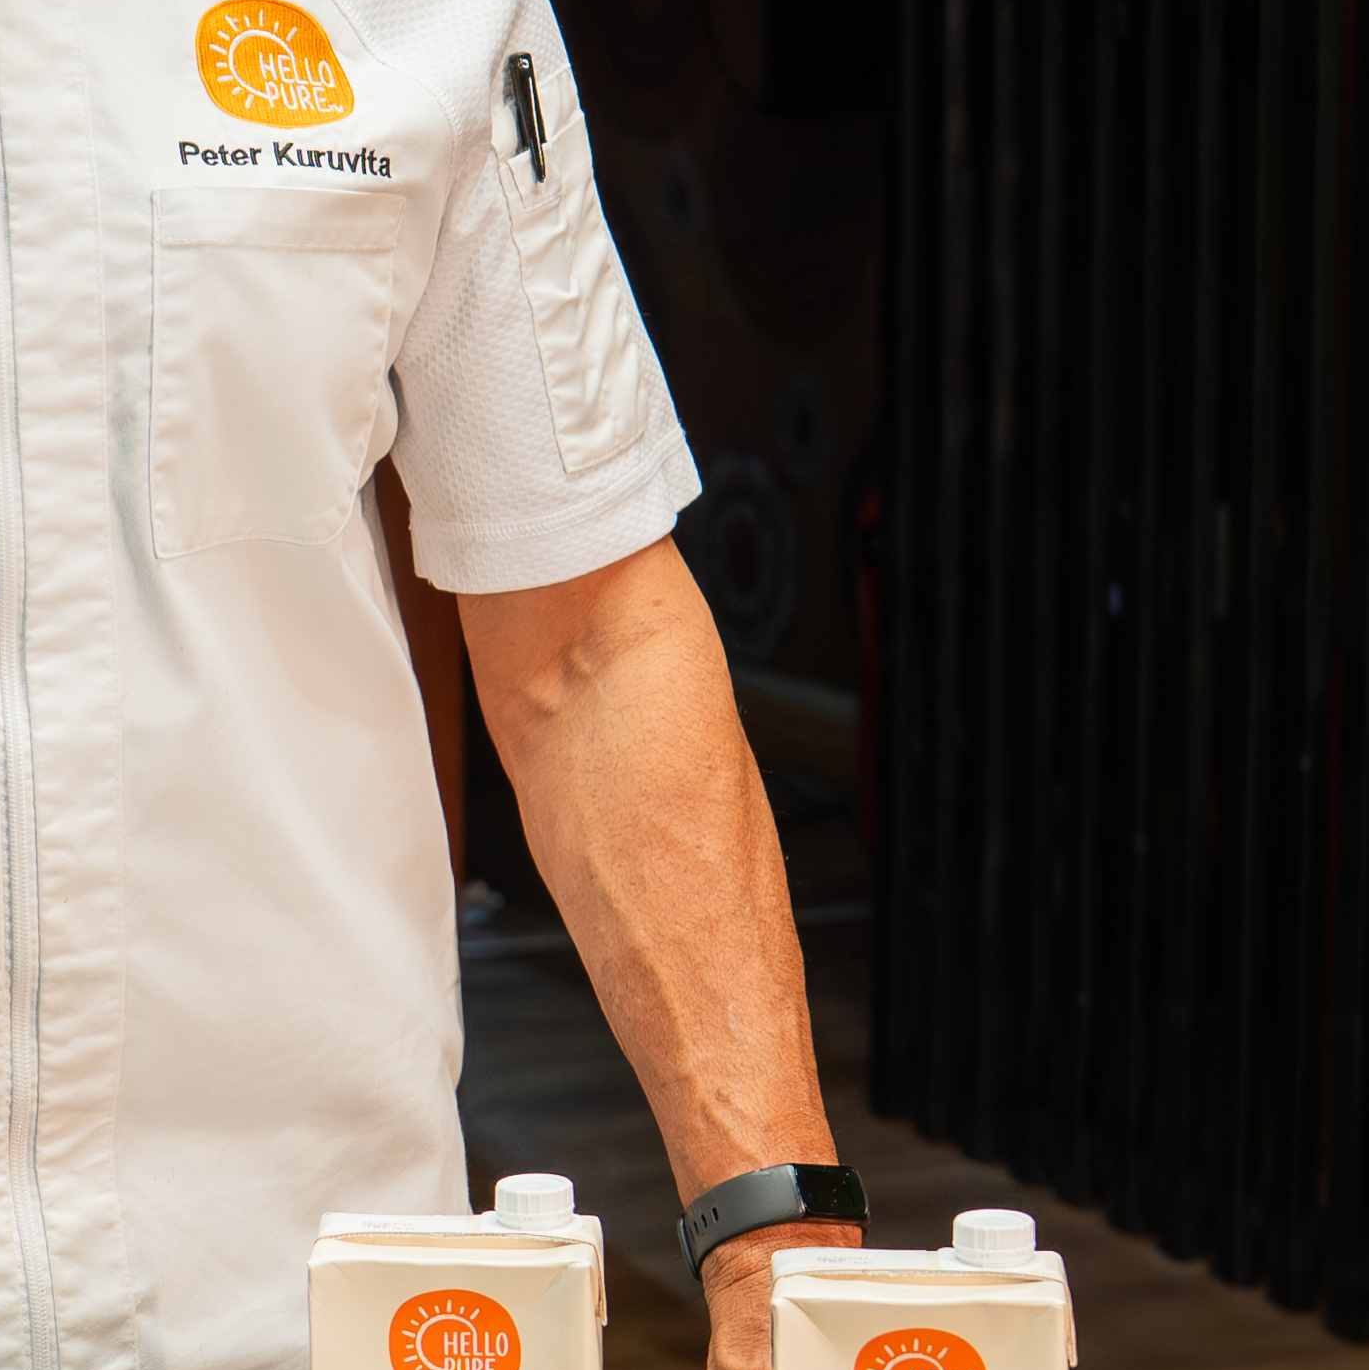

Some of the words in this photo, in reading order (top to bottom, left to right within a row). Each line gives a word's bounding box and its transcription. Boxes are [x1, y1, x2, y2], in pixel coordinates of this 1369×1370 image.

[259, 53, 335, 87] HELLO
[179, 141, 262, 166] Peter
[443, 1331, 509, 1357] HELLO
